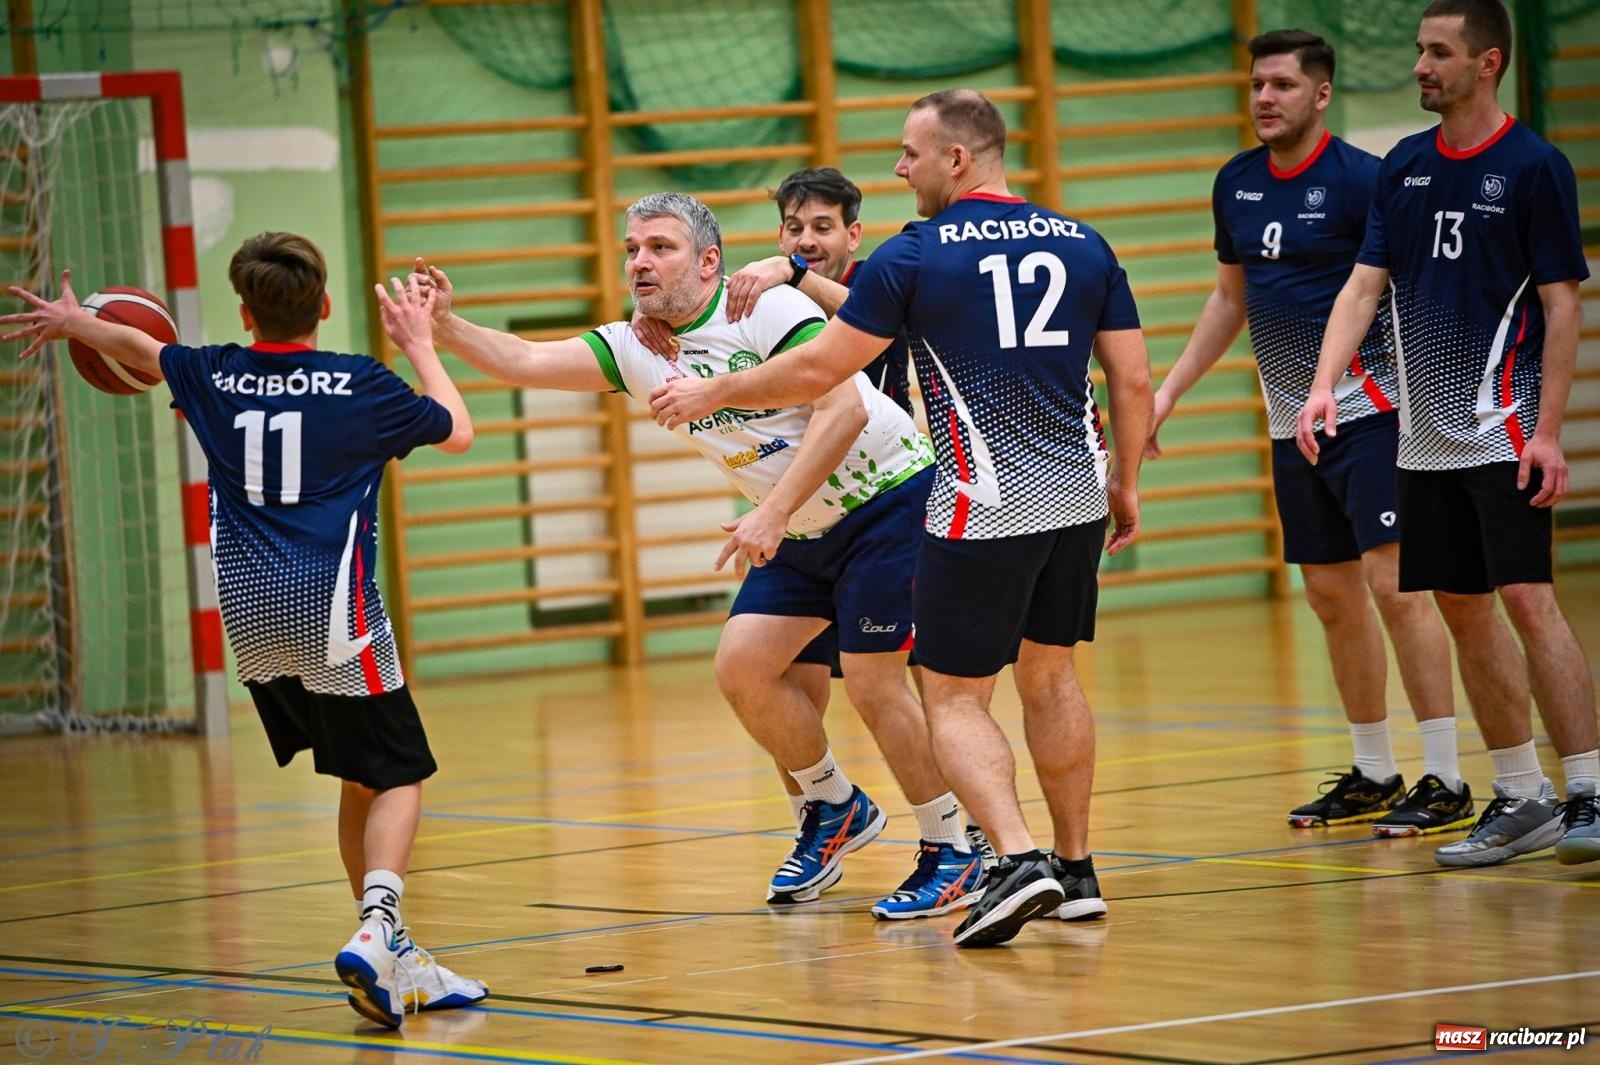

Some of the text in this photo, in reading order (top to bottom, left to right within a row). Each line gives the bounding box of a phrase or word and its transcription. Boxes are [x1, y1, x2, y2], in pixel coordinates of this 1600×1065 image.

[938, 212, 1086, 244] RACIBÓRZ
[1471, 202, 1505, 214] RACIBÓRZ
[1261, 221, 1282, 260] 9
[1432, 210, 1465, 260] 13
[978, 251, 1069, 349] 12
[233, 410, 302, 506] 11
